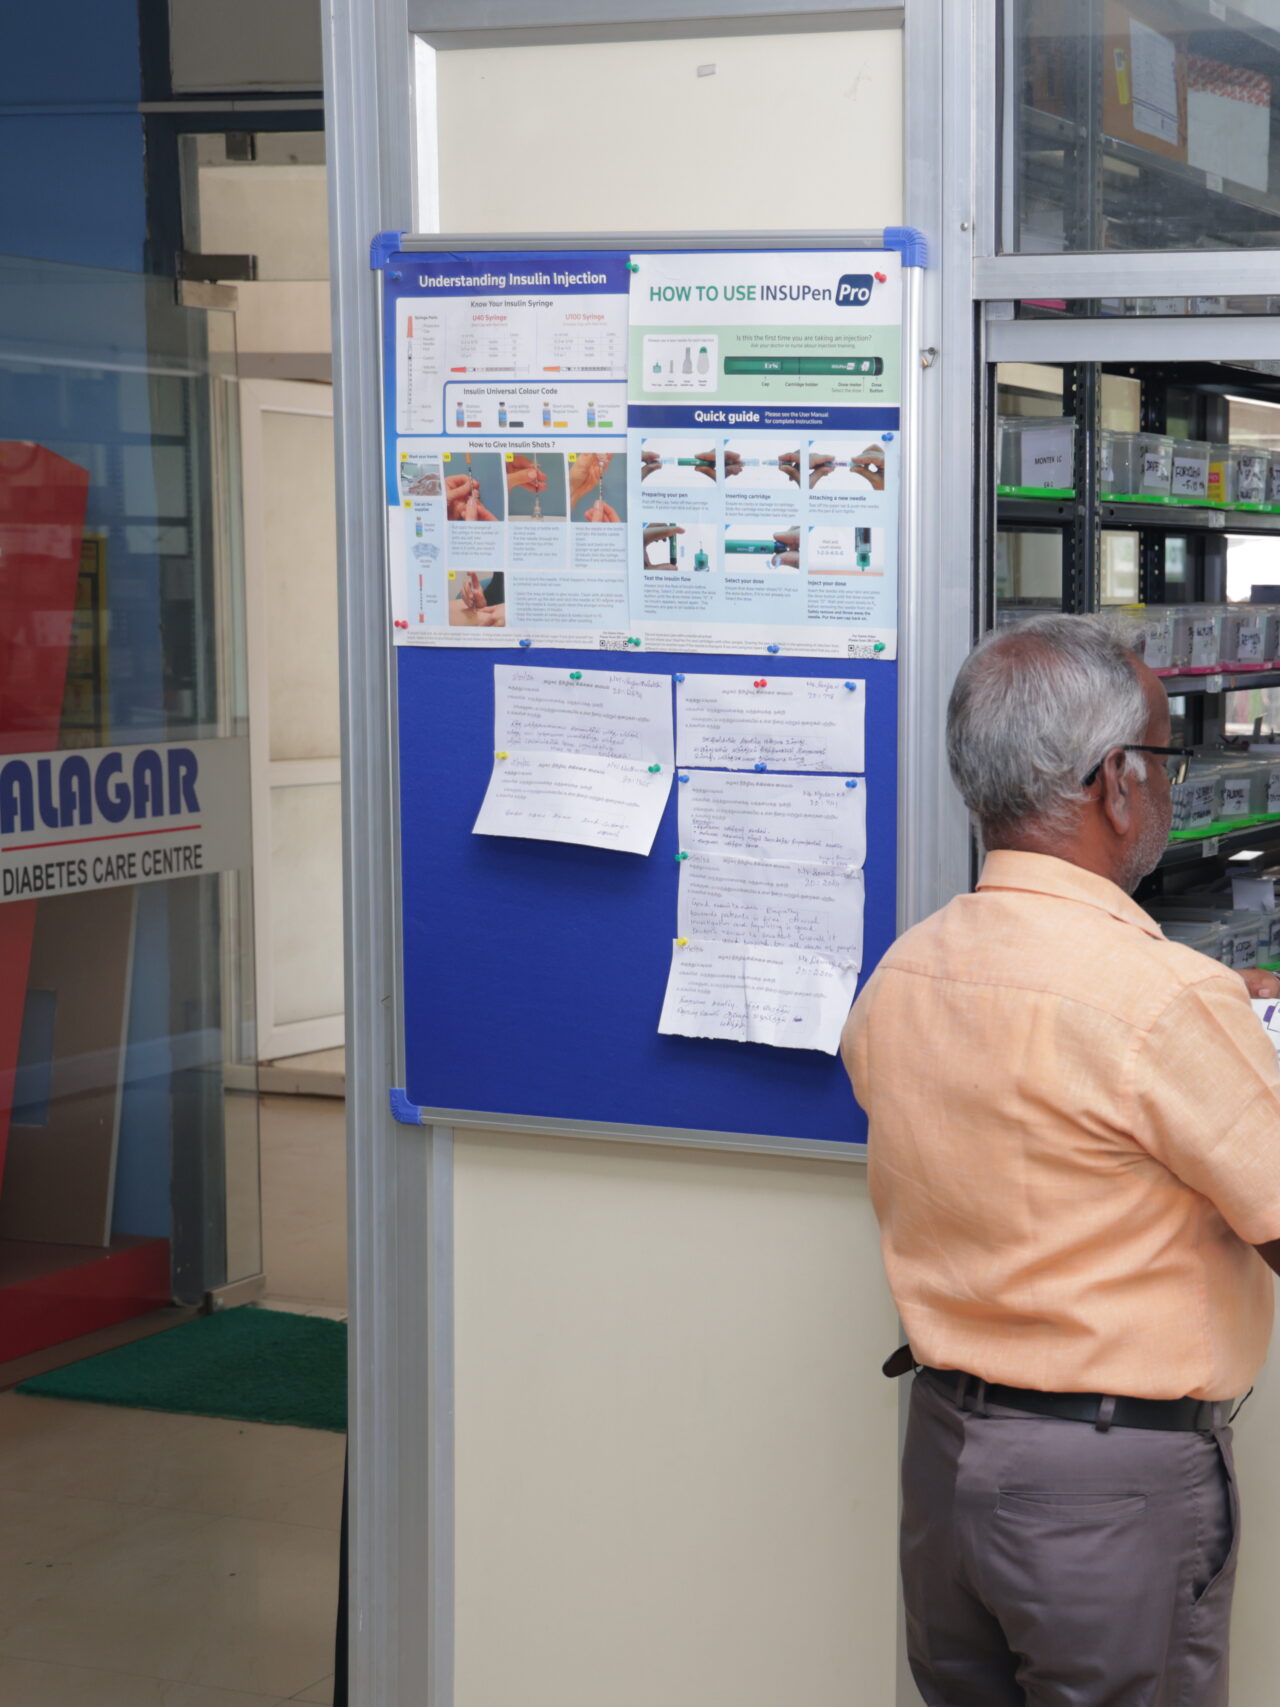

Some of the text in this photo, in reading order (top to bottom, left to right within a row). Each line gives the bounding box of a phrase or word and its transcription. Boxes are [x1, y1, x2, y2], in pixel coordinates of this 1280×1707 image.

[419, 272, 607, 289] Understanding Insulin Injection
[649, 283, 871, 302] HOW TO USE INSUPen Pro
[488, 300, 503, 308] Your
[528, 299, 553, 309] Syringe
[485, 314, 507, 322] Syringe
[582, 313, 605, 321] Syringe
[843, 335, 872, 343] injection?
[540, 387, 558, 395] Code
[694, 410, 760, 424] Quick guide
[531, 441, 550, 449] Shots
[0, 748, 201, 834] ALAGAR
[3, 844, 203, 897] DIABETES CARE CENTRE
